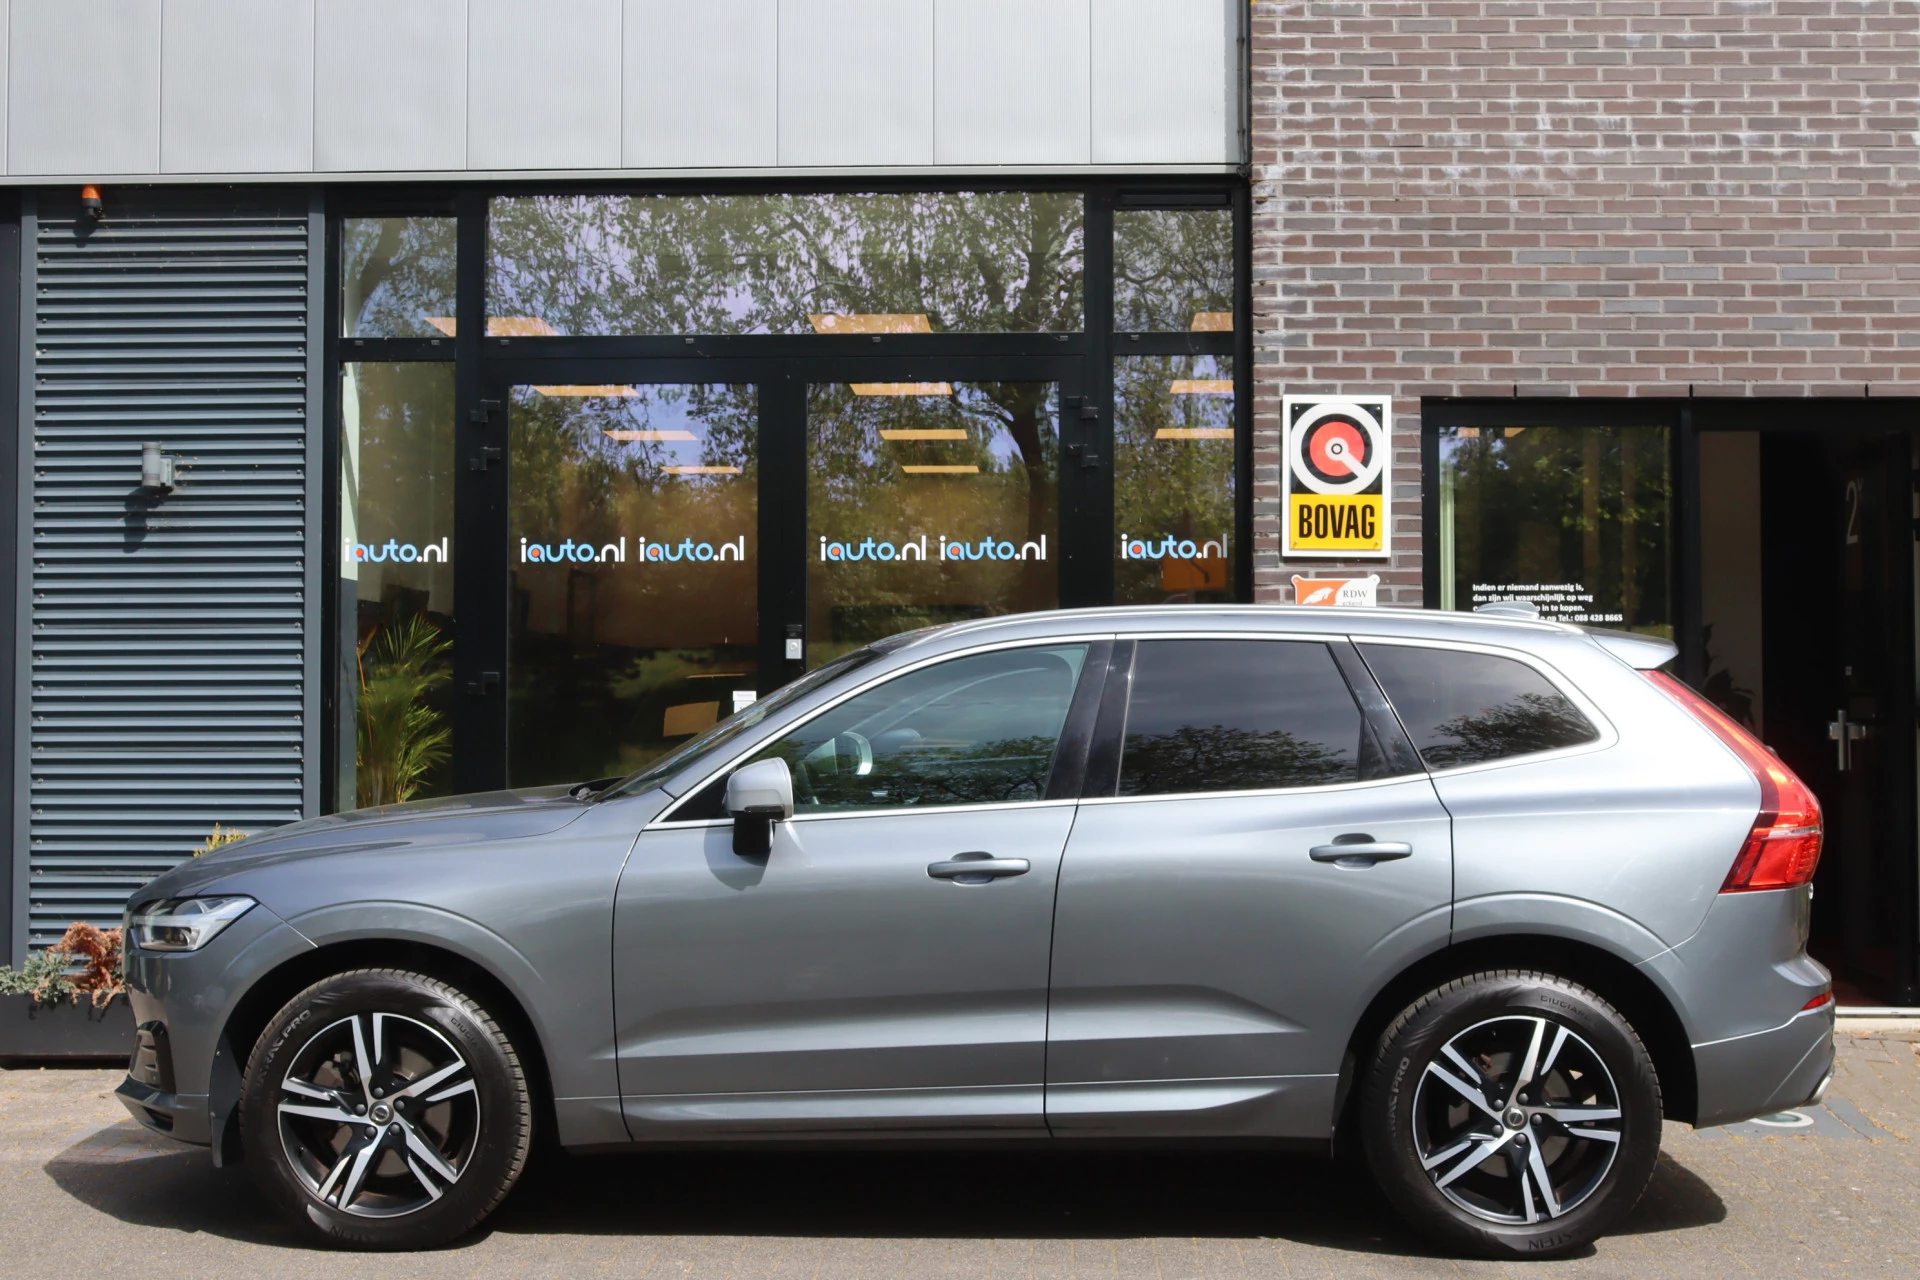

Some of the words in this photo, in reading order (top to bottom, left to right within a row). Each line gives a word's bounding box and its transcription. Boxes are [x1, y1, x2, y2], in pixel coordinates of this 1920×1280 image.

[1298, 503, 1375, 540] BOVAG
[343, 537, 449, 564] iauto.nl
[520, 536, 626, 563] iauto.nl
[639, 536, 745, 562] iauto.nl
[819, 535, 927, 562] iauto.nl
[939, 535, 1046, 561] iauto.nl
[1121, 534, 1228, 560] iauto.nl
[1343, 589, 1368, 598] RDW
[1472, 583, 1496, 592] Indien
[1497, 584, 1506, 592] er
[1506, 583, 1539, 592] niemand
[1540, 583, 1575, 593] aanwezig
[1472, 593, 1487, 602] dan
[1488, 593, 1502, 604] zijn
[1502, 593, 1514, 602] wij
[1515, 593, 1565, 604] waarschijnlijk
[1566, 594, 1576, 604] op
[1578, 594, 1593, 604] weg
[1541, 603, 1550, 612] in
[1550, 604, 1559, 612] te
[1559, 603, 1585, 613] kopen.
[1574, 613, 1588, 622] 088
[1590, 613, 1604, 622] 428
[1605, 613, 1623, 622] 8665
[281, 1008, 313, 1038] PRO
[1391, 1056, 1411, 1094] PRO
